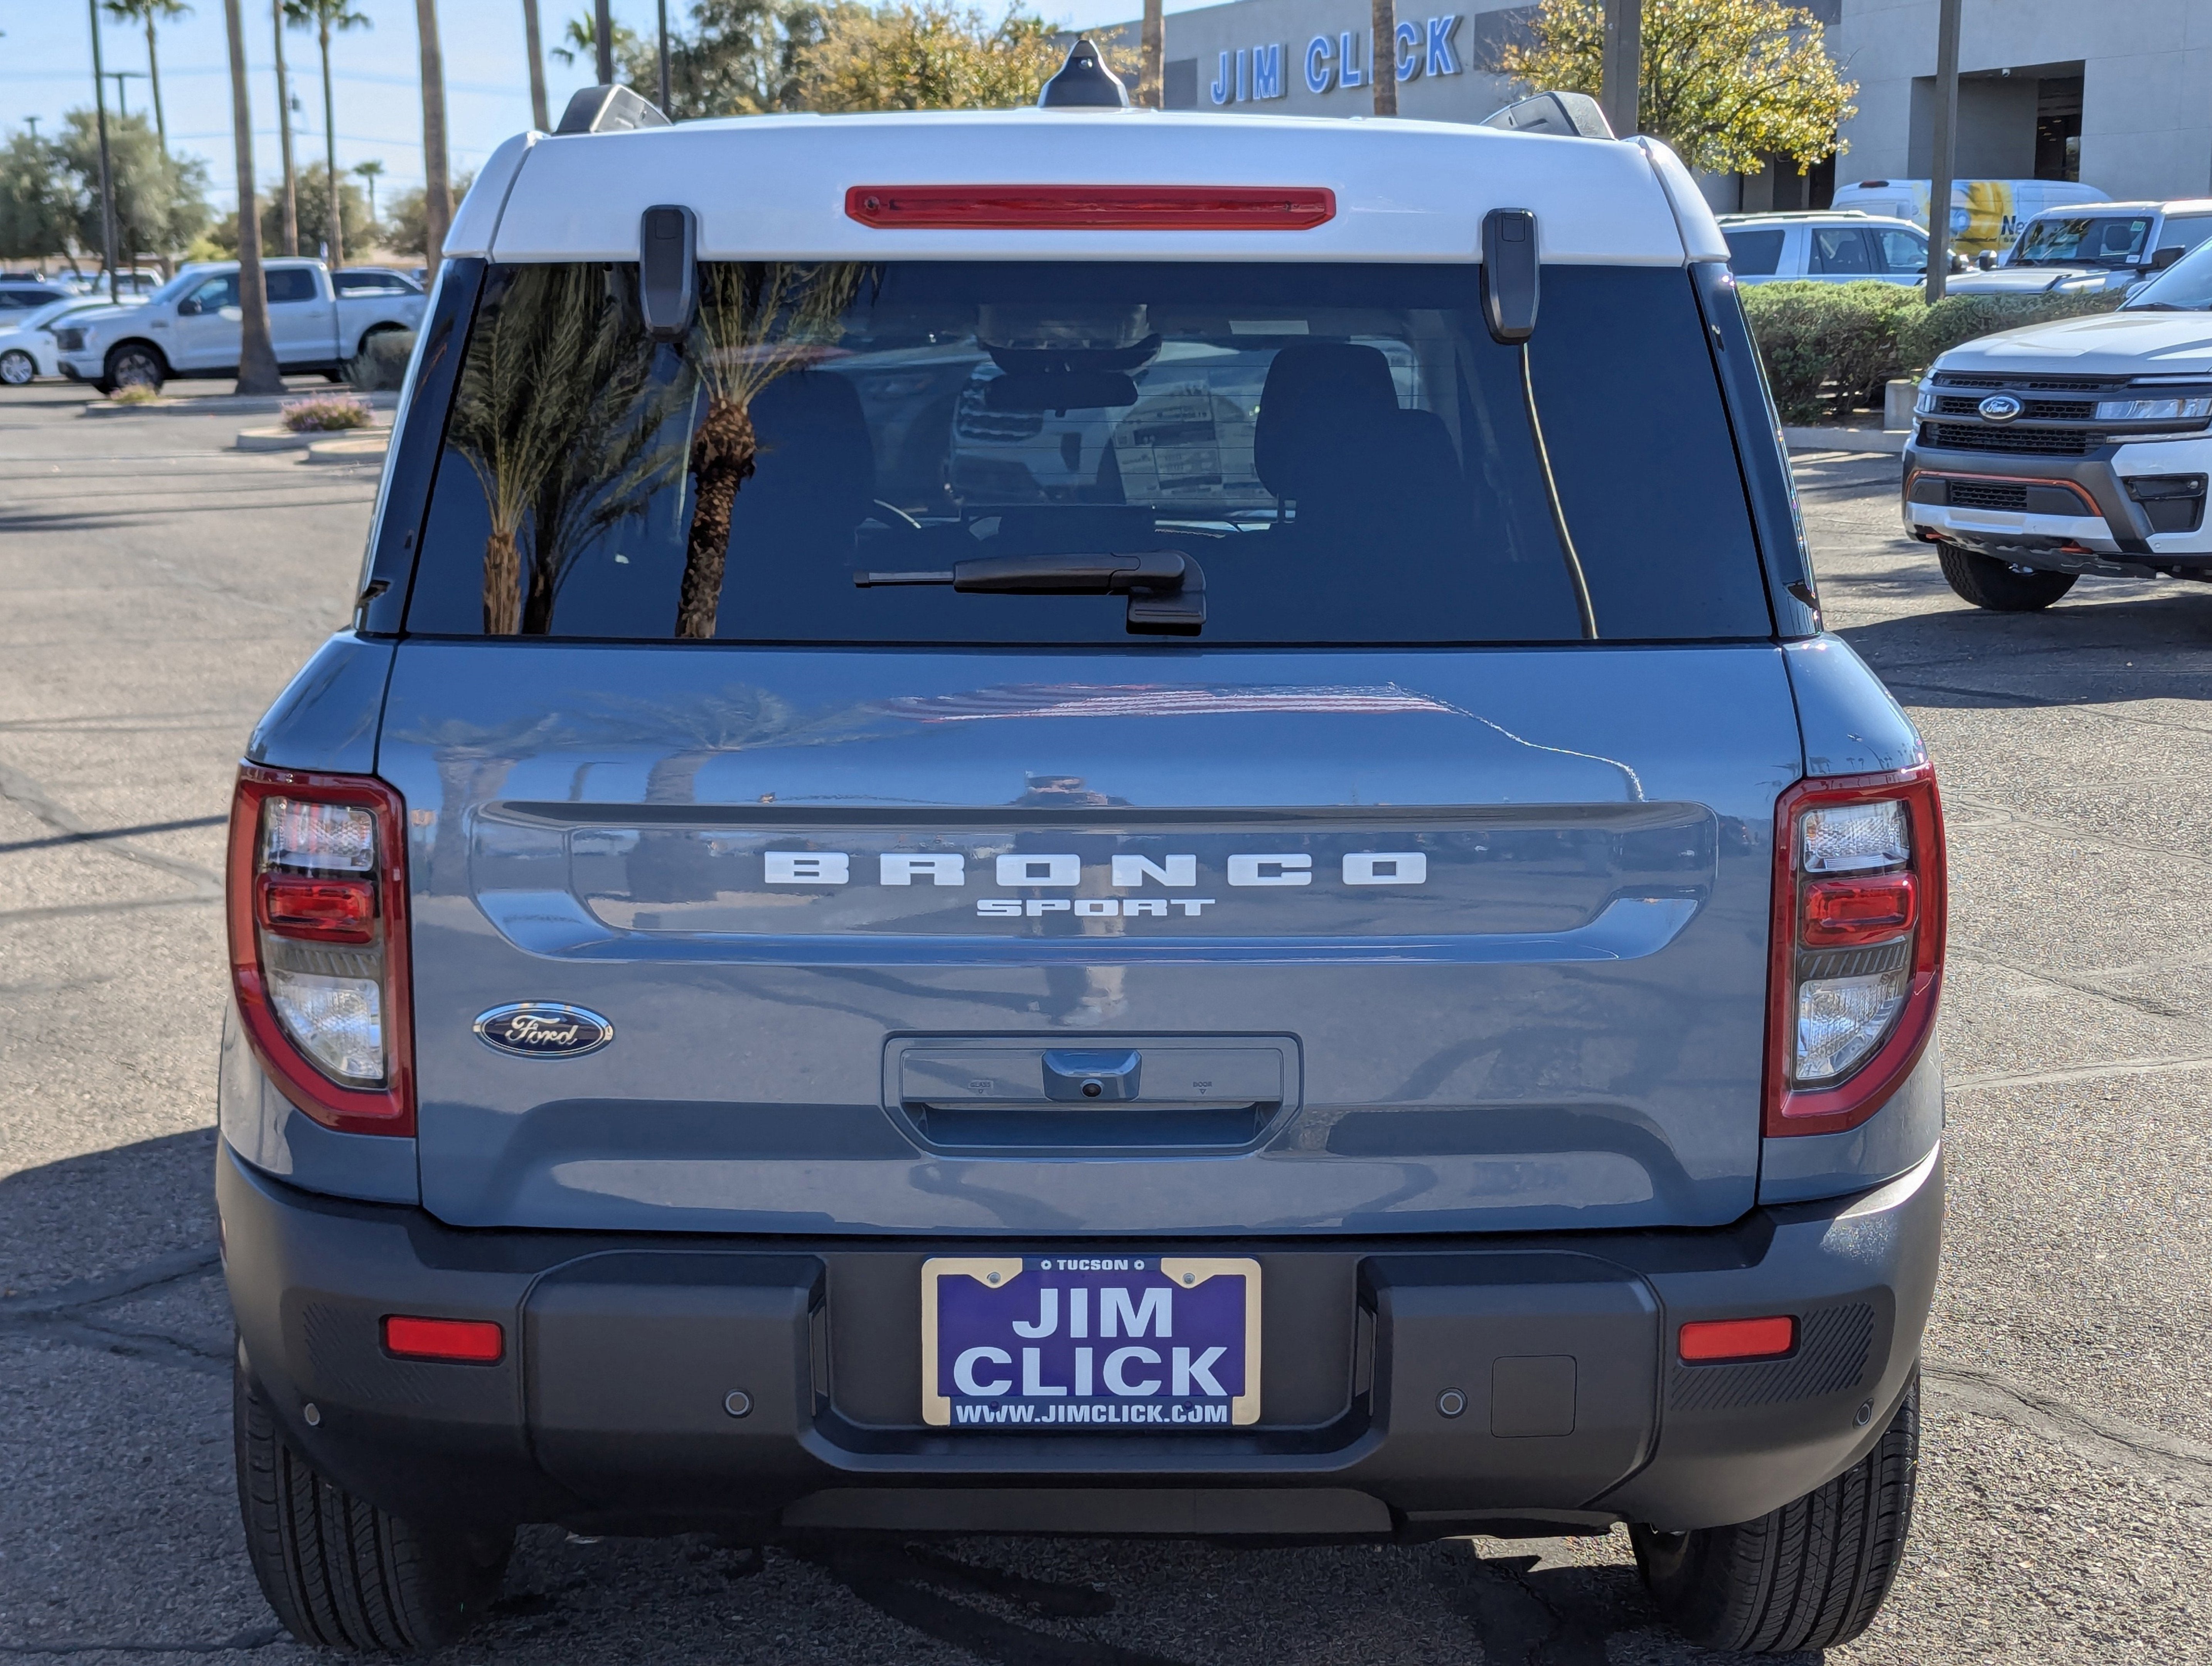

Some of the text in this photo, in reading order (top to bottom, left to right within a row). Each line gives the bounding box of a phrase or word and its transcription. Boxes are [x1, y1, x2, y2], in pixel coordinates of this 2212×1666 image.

[1211, 44, 1281, 105] JIM
[2001, 215, 2028, 235] Ne
[764, 850, 1428, 887] BRONCO
[977, 899, 1216, 917] SPORT
[505, 1015, 579, 1045] Ford
[1057, 1259, 1129, 1271] TUCSON
[1012, 1287, 1173, 1339] JIM
[953, 1346, 1228, 1396] CLICK
[955, 1405, 1228, 1423] WWW.JIMCLICK.COM
